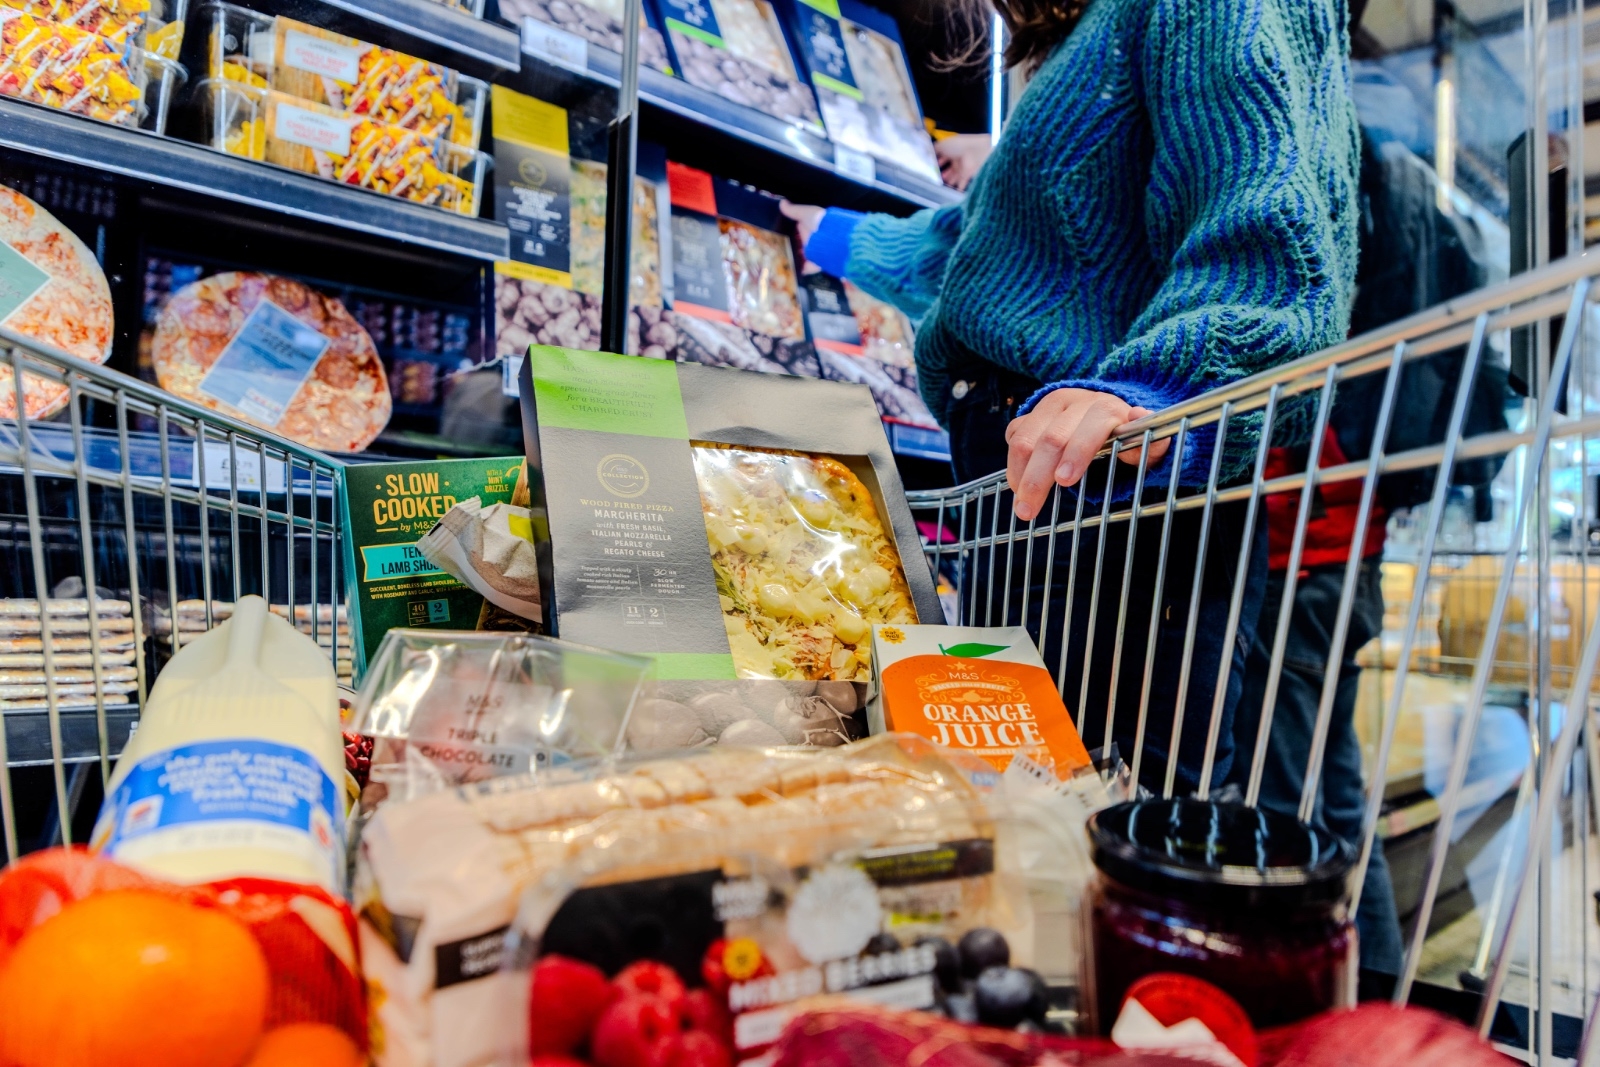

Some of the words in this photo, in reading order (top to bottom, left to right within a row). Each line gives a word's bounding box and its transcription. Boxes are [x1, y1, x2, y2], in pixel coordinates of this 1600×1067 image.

[566, 394, 578, 402] for
[590, 397, 654, 409] BEAUTIFULLY
[572, 404, 620, 415] CHARRED
[622, 409, 653, 418] CRUST
[603, 472, 644, 480] COLLECTION
[385, 472, 439, 496] SLOW
[484, 484, 509, 493] DRIZZLE
[580, 499, 611, 508] WOOD
[614, 501, 643, 510] FIRED
[646, 504, 674, 512] PIZZA
[594, 509, 664, 522] MARGHERITA
[400, 523, 411, 533] by
[413, 520, 436, 530] M&S
[596, 521, 614, 529] with
[616, 523, 640, 531] FRESH
[642, 524, 666, 533] BASIL,
[591, 529, 621, 538] ITALIAN
[624, 531, 672, 541] MOZZARELLA
[615, 540, 643, 548] PEARLS
[604, 548, 634, 556] REGATO
[636, 549, 665, 558] CHEESE
[381, 561, 411, 575] LAMB
[653, 568, 667, 577] 30
[369, 584, 397, 593] SUCCULENT,
[412, 603, 425, 613] 40
[433, 602, 443, 613] 2
[626, 606, 638, 614] 11
[649, 607, 659, 618] 2
[949, 672, 979, 680] M&S
[923, 703, 1036, 722] ORANGE
[449, 728, 497, 744] TRIPLE
[931, 722, 1045, 747] JUICE
[420, 745, 517, 769] CHOCOLATE
